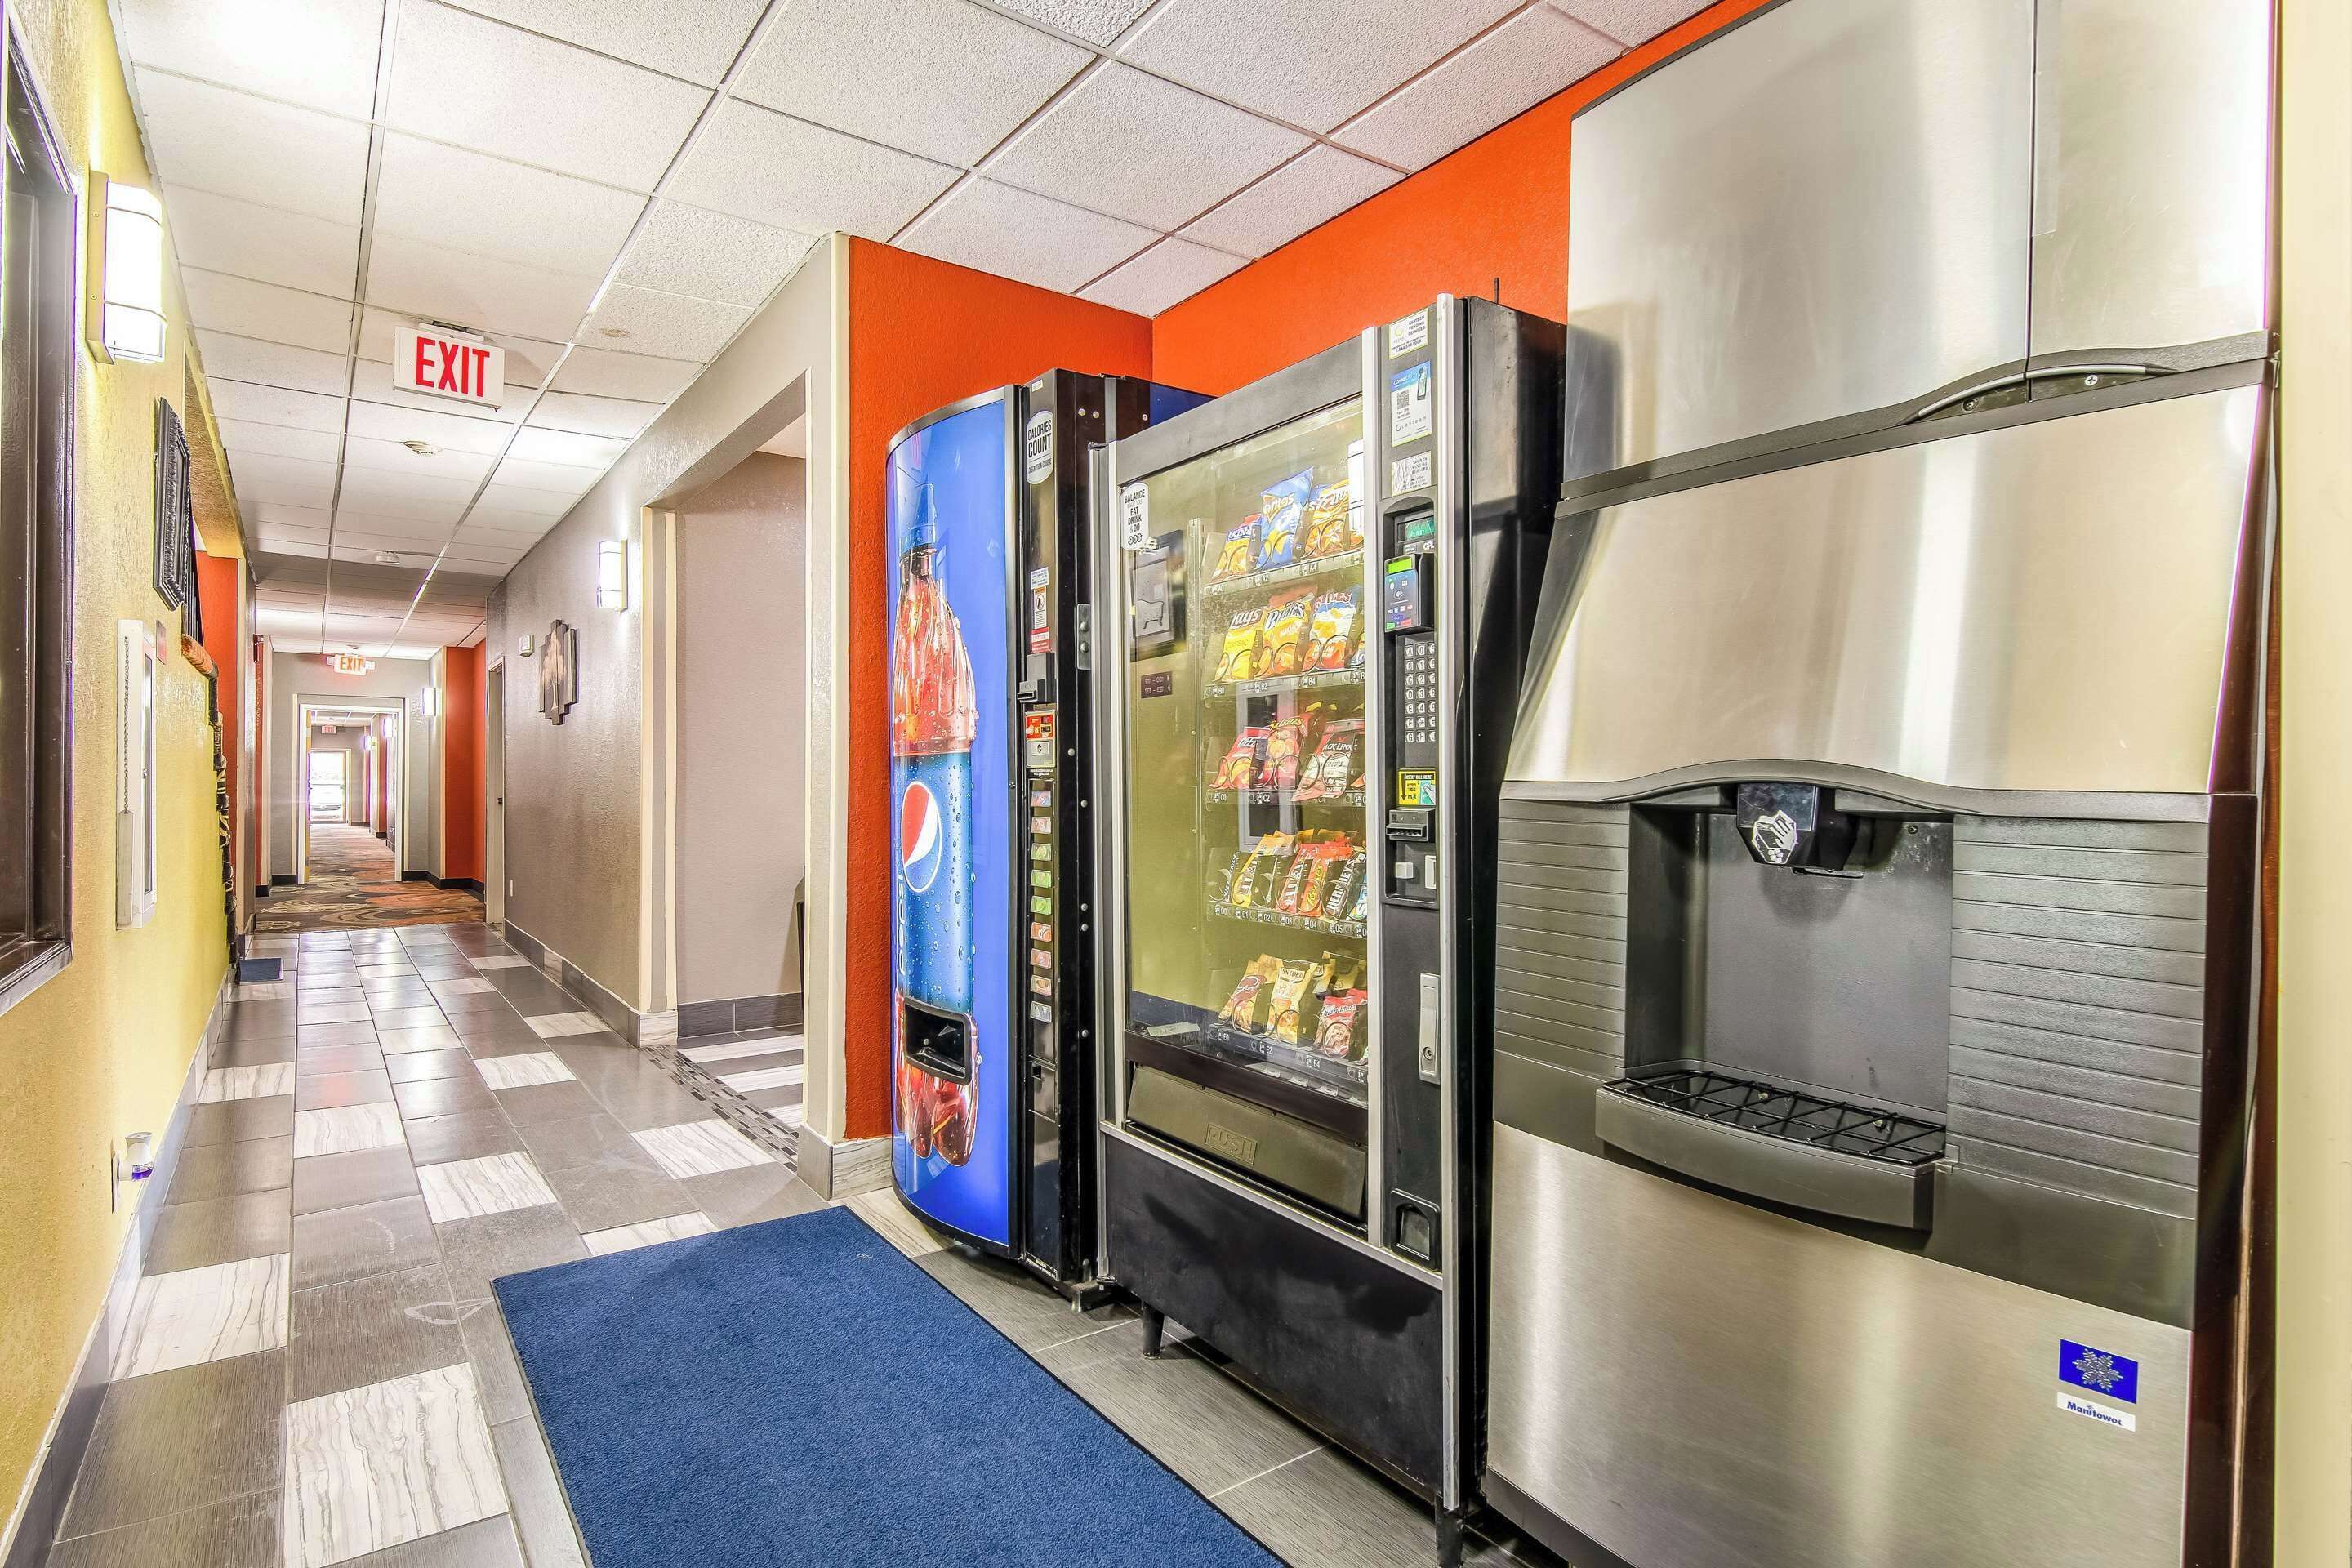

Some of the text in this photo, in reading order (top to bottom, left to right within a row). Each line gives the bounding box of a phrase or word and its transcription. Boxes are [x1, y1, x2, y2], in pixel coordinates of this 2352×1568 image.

[415, 336, 491, 398] EXIT
[1027, 419, 1052, 441] CALORIES
[1028, 433, 1052, 458] COUNT
[1124, 489, 1146, 504] BALANCE
[1130, 506, 1139, 516] EAT
[1128, 514, 1143, 526] DRINK
[1134, 523, 1141, 532] DO
[339, 656, 364, 671] EXIT
[1336, 742, 1354, 751] LINK
[898, 874, 906, 976] pepsi
[1313, 1059, 1321, 1068] E4
[1209, 1127, 1254, 1161] PUSH
[2067, 1401, 2124, 1427] Manitowoc
